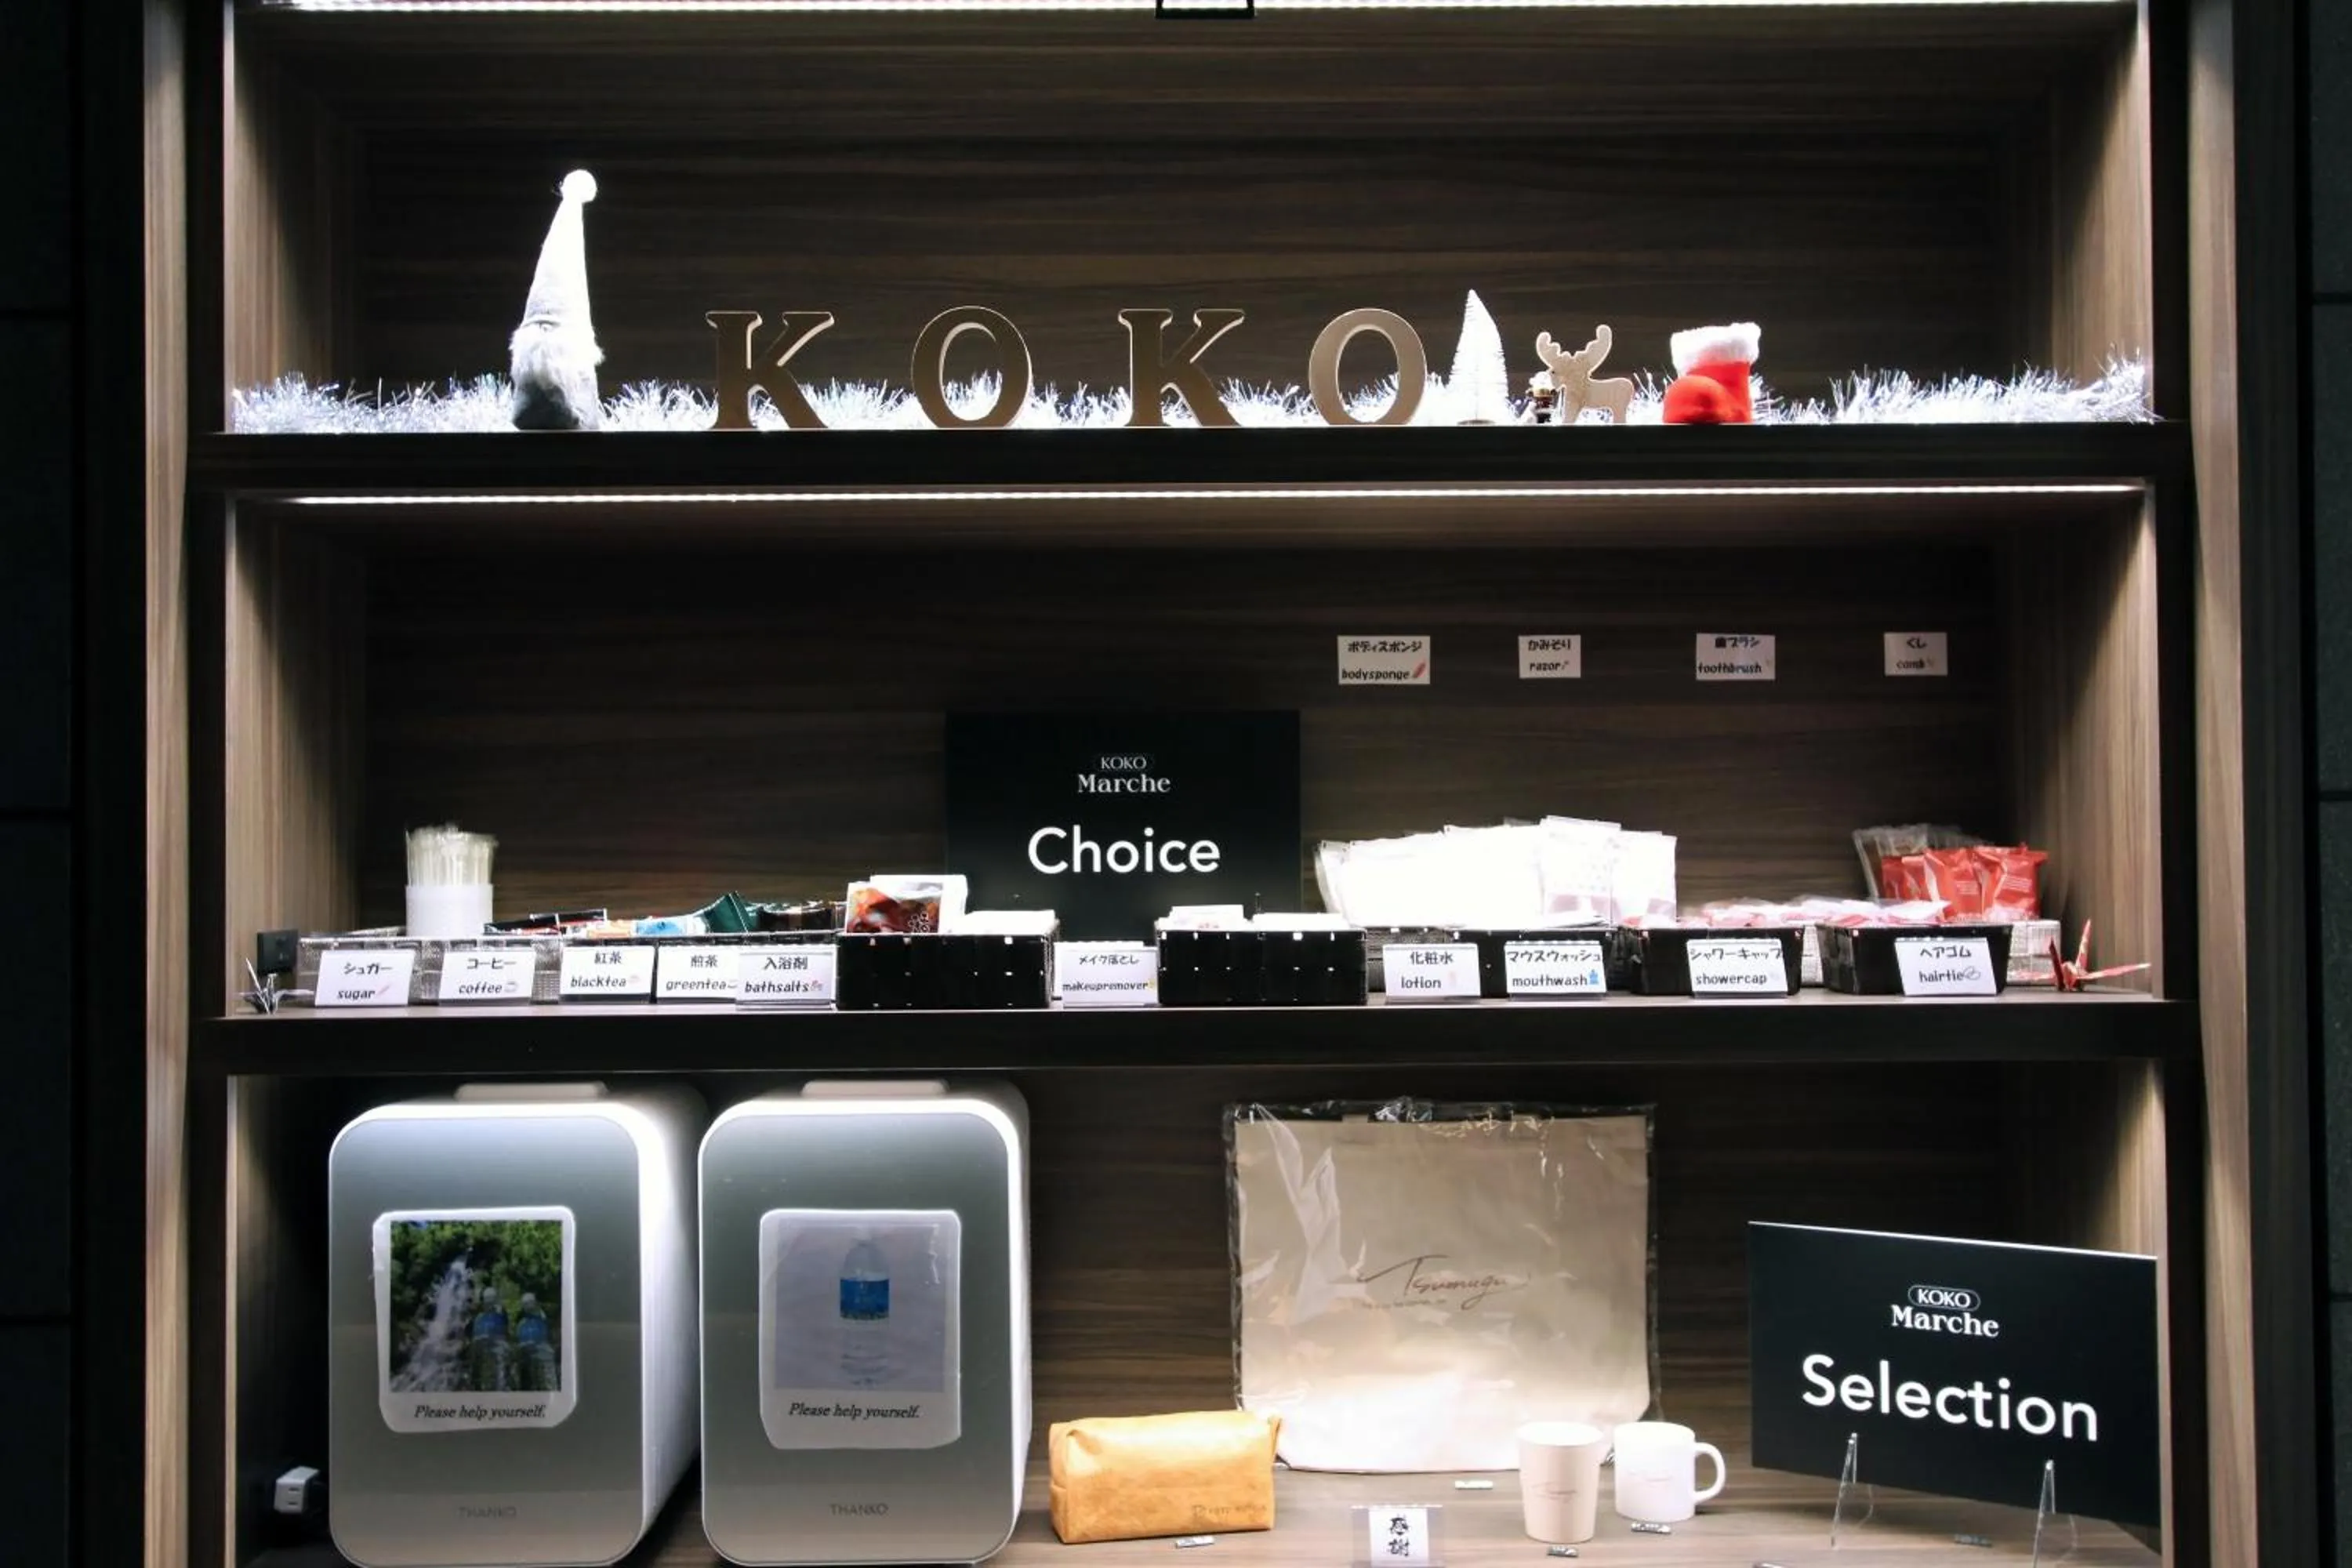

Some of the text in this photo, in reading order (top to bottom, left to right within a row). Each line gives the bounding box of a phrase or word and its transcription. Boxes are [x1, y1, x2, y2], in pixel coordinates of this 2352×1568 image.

[706, 304, 1428, 427] KOKO
[1527, 638, 1571, 652] かみそり
[1906, 637, 1928, 649] くし
[1529, 660, 1562, 673] razor
[1697, 661, 1763, 674] toothbrush
[1341, 667, 1410, 682] bodysponge
[1100, 756, 1147, 770] KOKO
[1077, 773, 1171, 793] Marche
[1027, 824, 1221, 875] Choice
[593, 951, 622, 965] 紅茶
[1409, 950, 1454, 964] 化粧水
[1506, 949, 1601, 964] マウスウォッシュ
[1918, 945, 1972, 958] ヘアゴム
[466, 957, 517, 971] コーヒー
[690, 954, 719, 968] 煎茶
[763, 956, 808, 971] 入浴剤
[1078, 954, 1140, 965] メイク落とし
[343, 961, 394, 975] シュガー
[570, 976, 627, 989] blacktea
[1400, 975, 1442, 989] lotion
[1512, 974, 1588, 987] mouthwash
[1695, 969, 1768, 985] showercap
[1918, 969, 1965, 982] hairtie
[458, 982, 503, 995] coffee
[666, 979, 726, 993] greentea
[744, 980, 810, 993] bathsalts
[337, 989, 376, 1001] sugar
[1918, 1287, 1971, 1309] KOKO
[1890, 1304, 2000, 1338] Marche
[1802, 1352, 2098, 1442] Selection
[414, 1404, 546, 1421] Please help yourself.
[788, 1402, 920, 1421] Please help yourself.
[829, 1502, 890, 1516] THANKO
